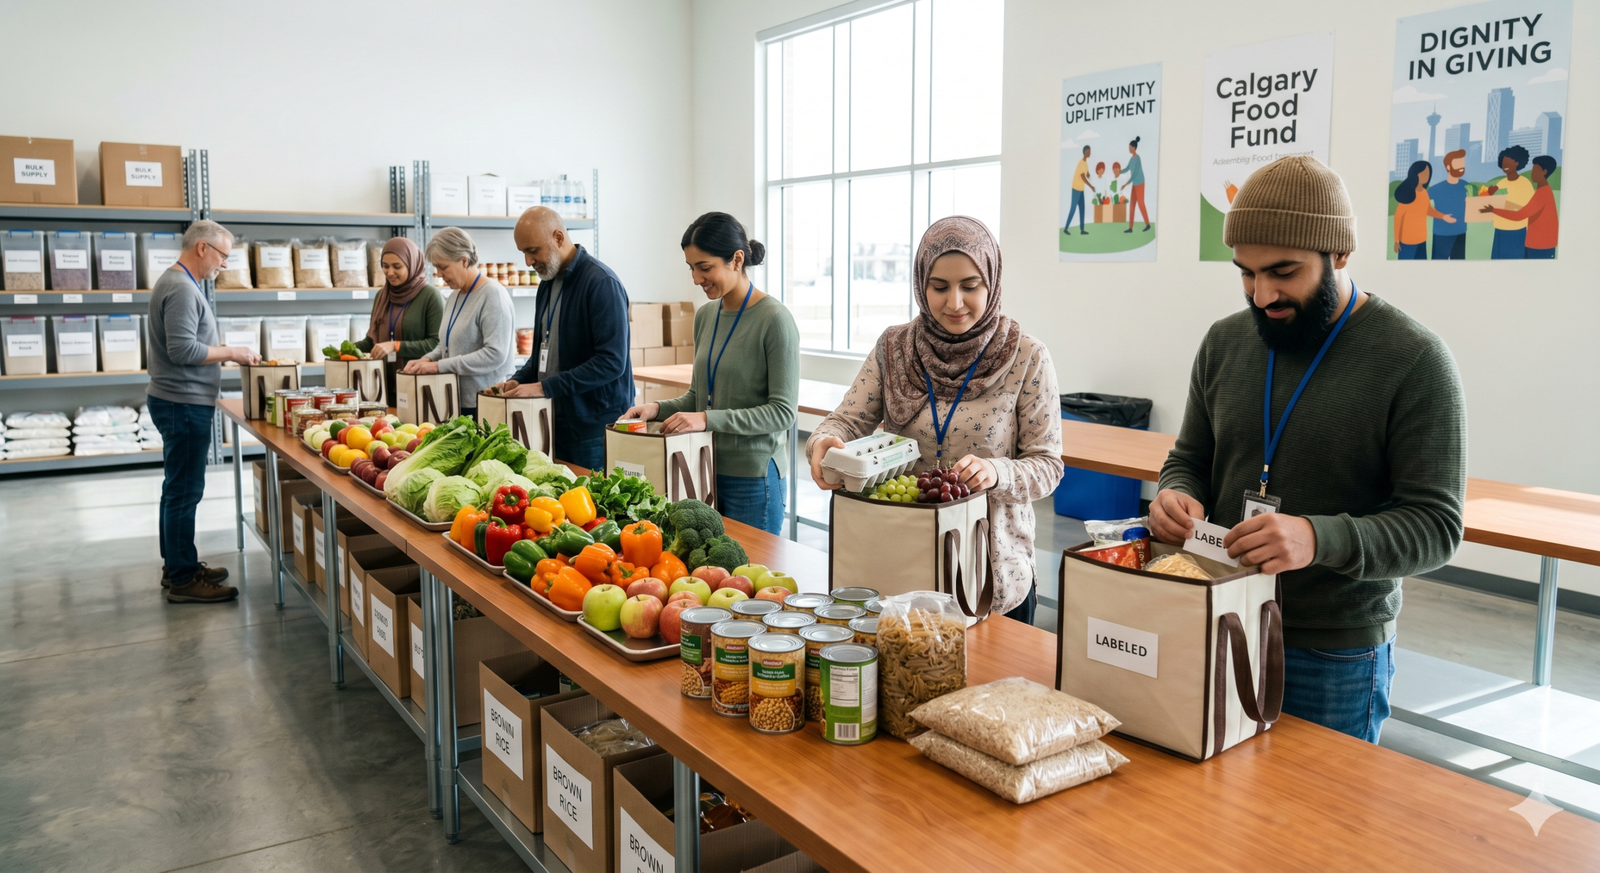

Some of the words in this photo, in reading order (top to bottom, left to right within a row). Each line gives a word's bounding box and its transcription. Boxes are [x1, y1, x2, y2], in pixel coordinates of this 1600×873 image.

[1420, 13, 1543, 54] DIGNITY
[1409, 57, 1436, 81] IN
[1445, 41, 1552, 75] GIVING
[1066, 80, 1156, 107] COMMUNITY
[1216, 68, 1318, 99] Calgary
[1066, 99, 1156, 125] UPLIFTMENT
[1231, 93, 1298, 123] Food
[1230, 119, 1297, 149] Fund
[1252, 153, 1273, 163] Food
[1195, 529, 1226, 549] LABE
[1095, 633, 1148, 657] LABELED
[495, 732, 511, 756] RICE
[553, 765, 582, 802] BROWN
[559, 793, 578, 822] RICE
[629, 833, 664, 873] BROWN
